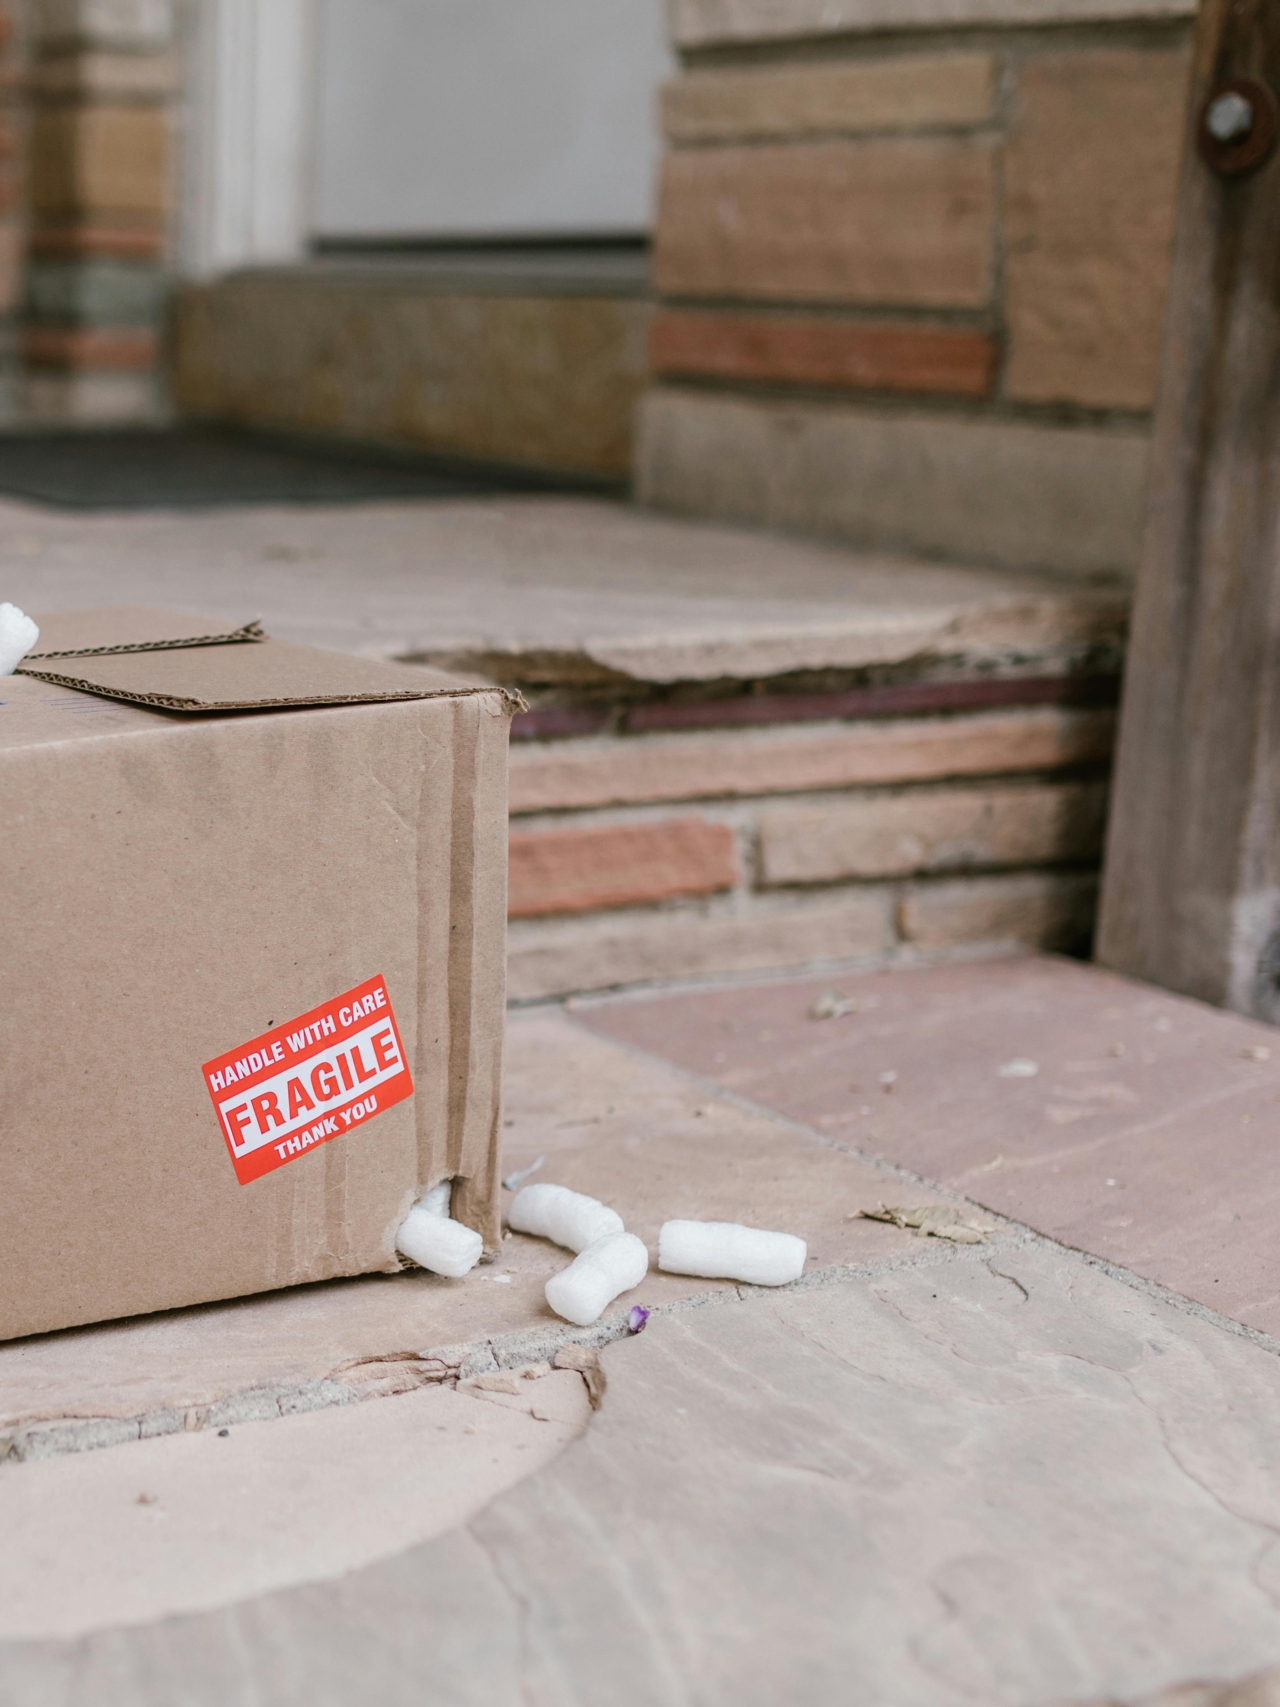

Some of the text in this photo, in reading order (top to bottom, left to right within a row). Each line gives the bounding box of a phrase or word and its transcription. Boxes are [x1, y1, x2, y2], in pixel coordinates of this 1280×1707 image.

[209, 987, 387, 1092] HANDLE WITH CARE
[225, 1027, 399, 1147] FRAGILE
[274, 1094, 378, 1160] THANK YOU
